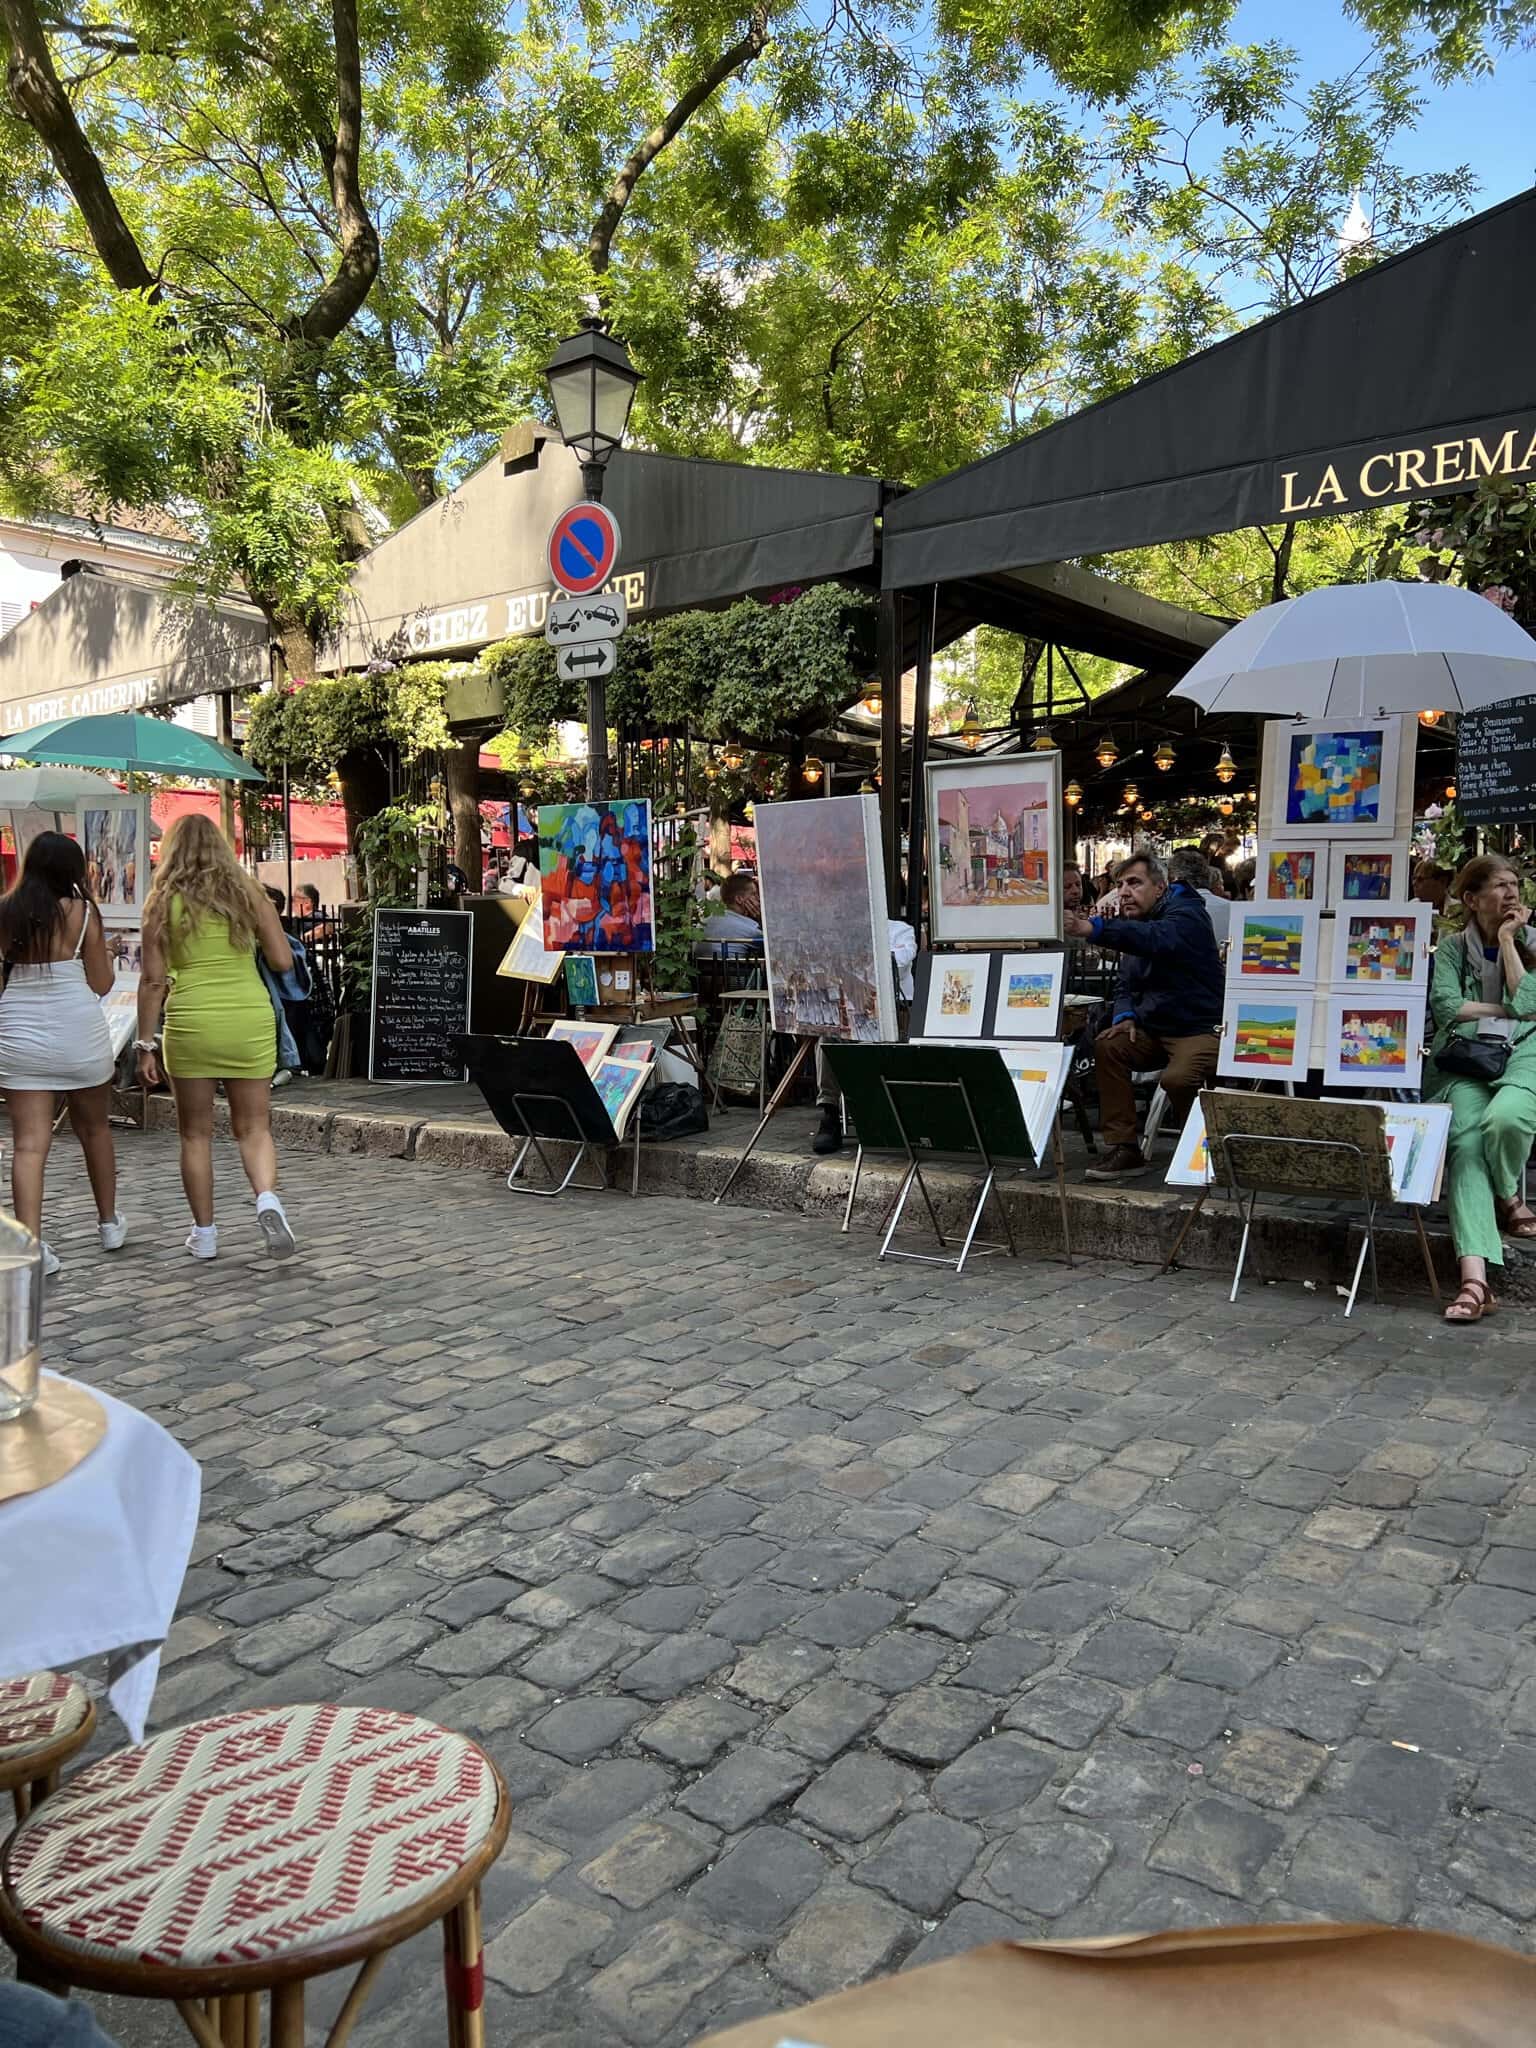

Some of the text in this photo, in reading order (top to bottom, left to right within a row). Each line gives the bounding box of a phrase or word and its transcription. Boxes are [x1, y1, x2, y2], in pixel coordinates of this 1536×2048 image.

[1279, 463, 1349, 514] LA
[408, 571, 645, 650] CHEZ EUNE
[6, 707, 24, 730] LA
[71, 677, 158, 716] CATHERINE
[407, 926, 441, 934] ABATILLES
